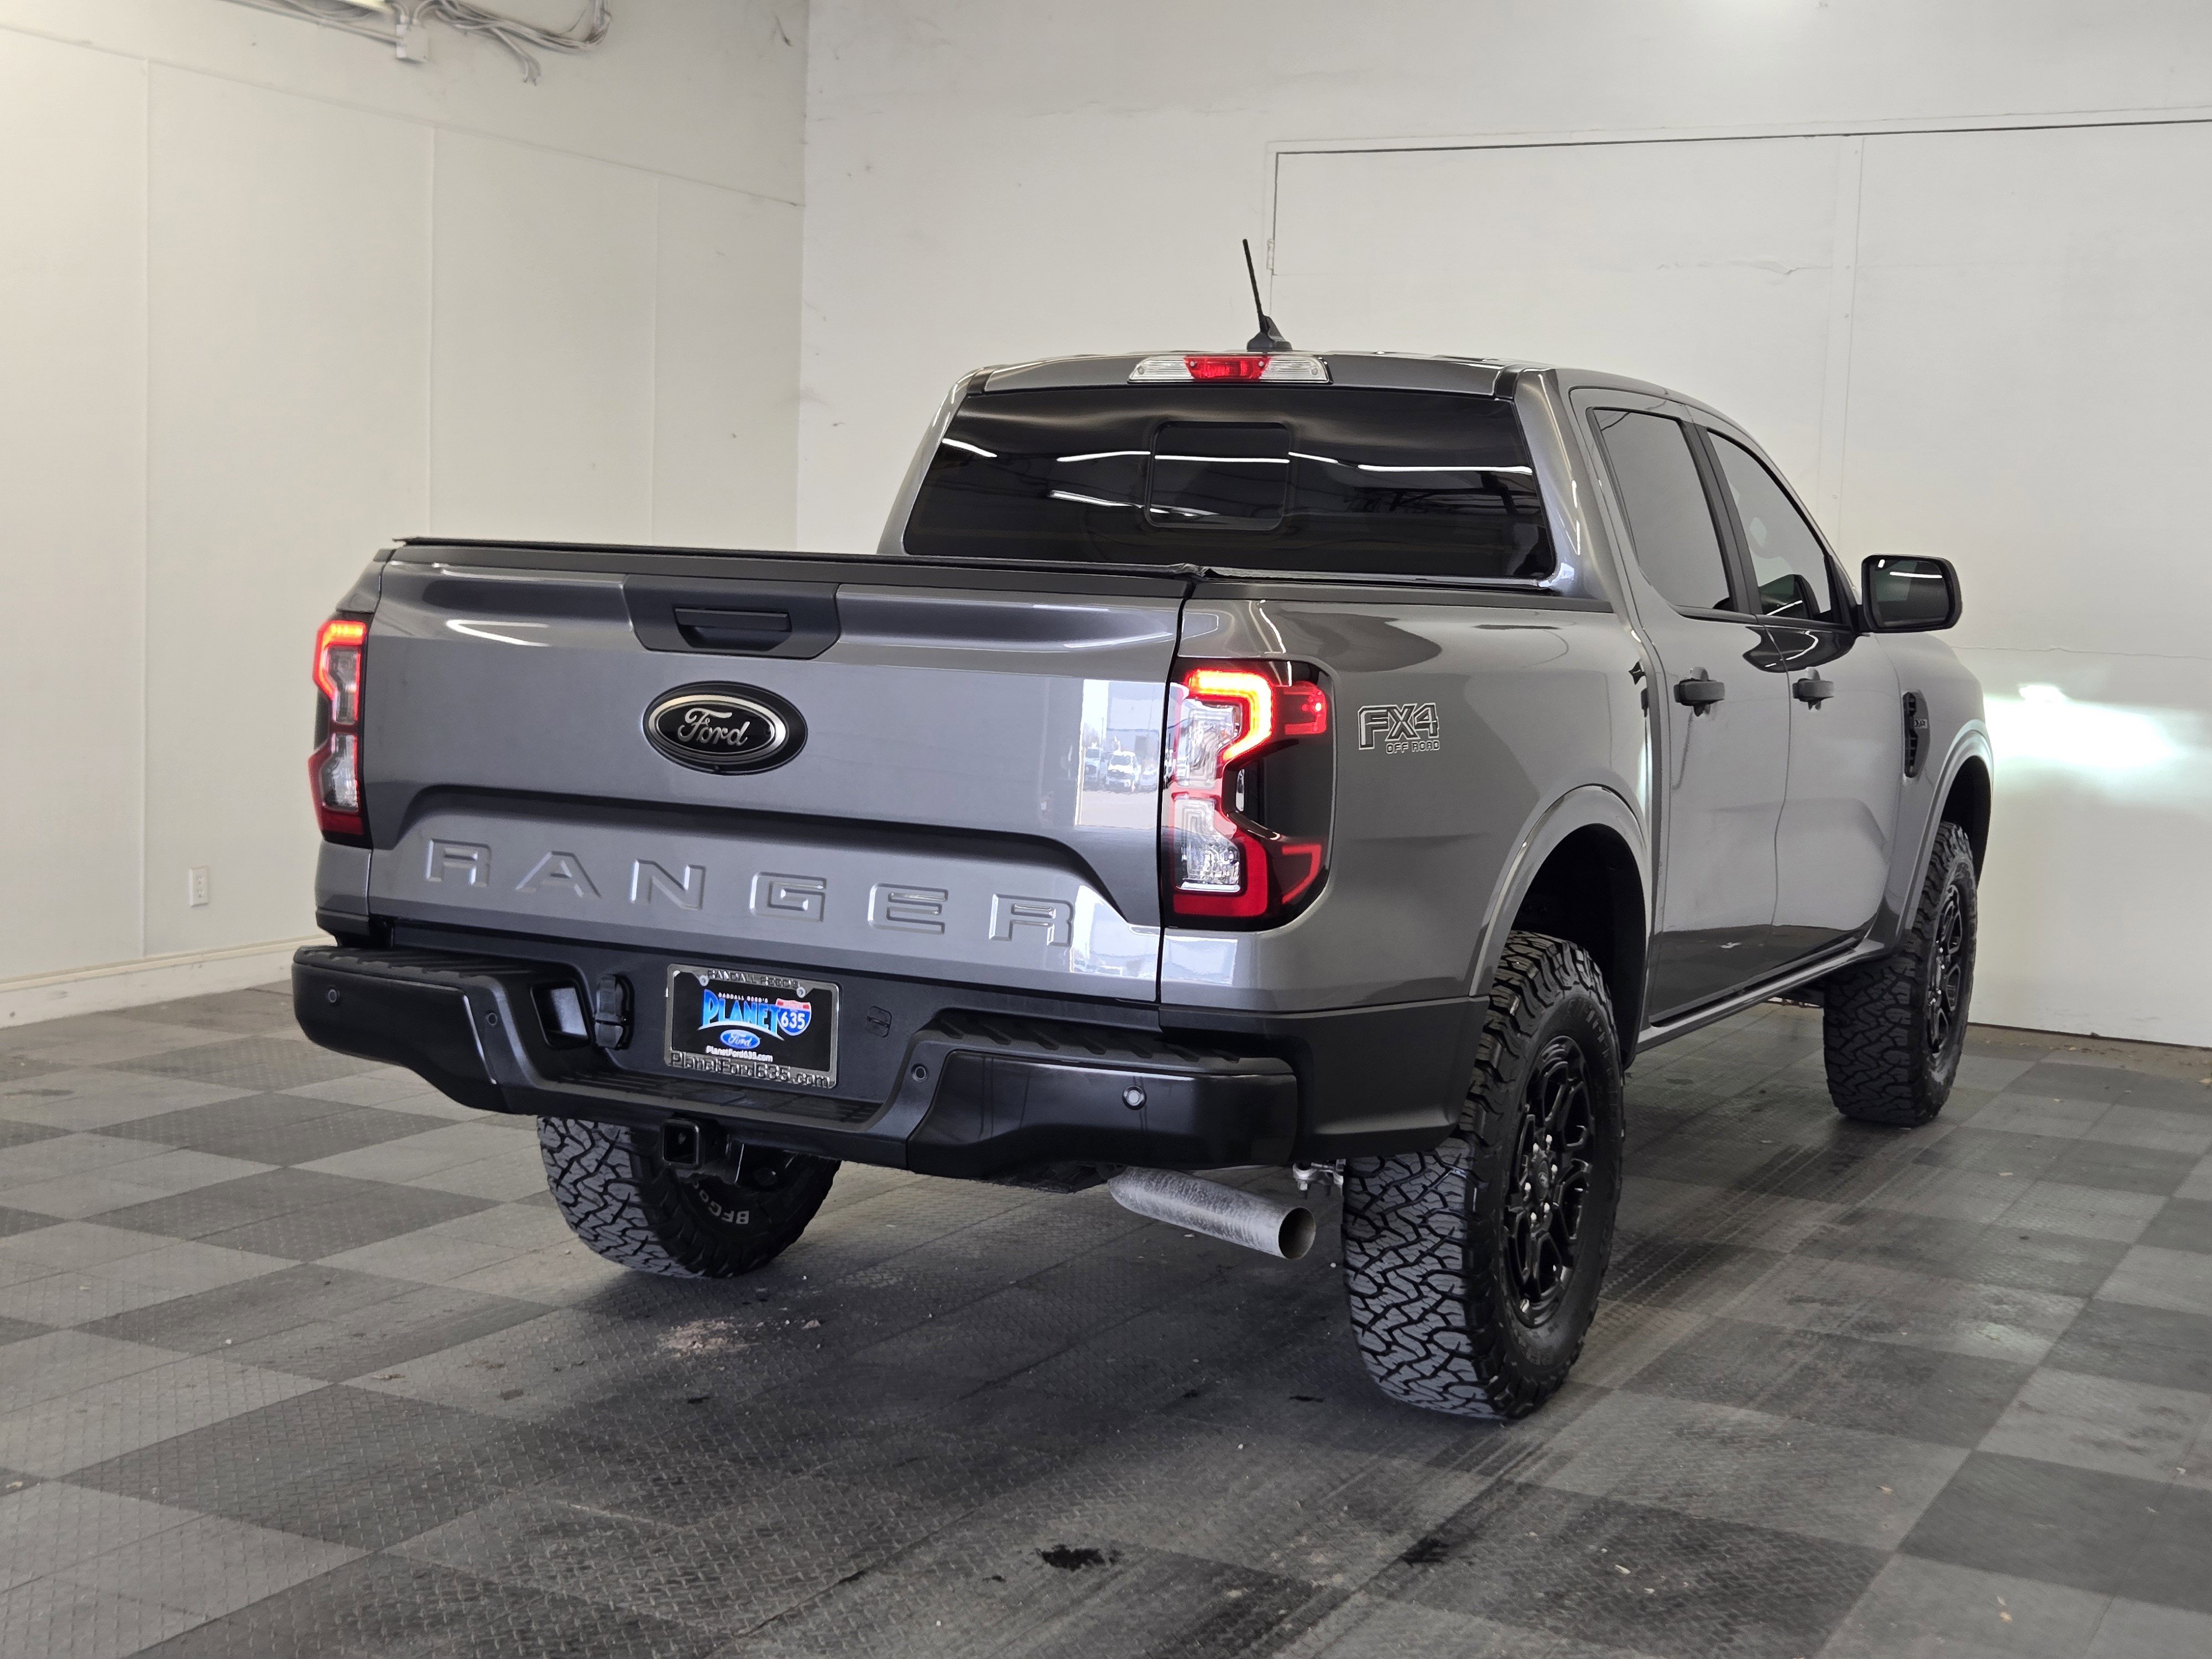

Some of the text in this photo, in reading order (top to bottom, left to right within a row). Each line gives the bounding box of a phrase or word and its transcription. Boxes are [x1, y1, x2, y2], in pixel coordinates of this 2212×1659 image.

[678, 708, 749, 746] Ford
[1358, 702, 1439, 750] FX4
[1386, 740, 1440, 754] OFF ROAD
[425, 838, 1074, 947] RANGER
[707, 969, 758, 984] RANDALL
[703, 989, 805, 1035] PLANET 635
[728, 1031, 753, 1047] Ford
[670, 1051, 831, 1088] PlanetFord635.com
